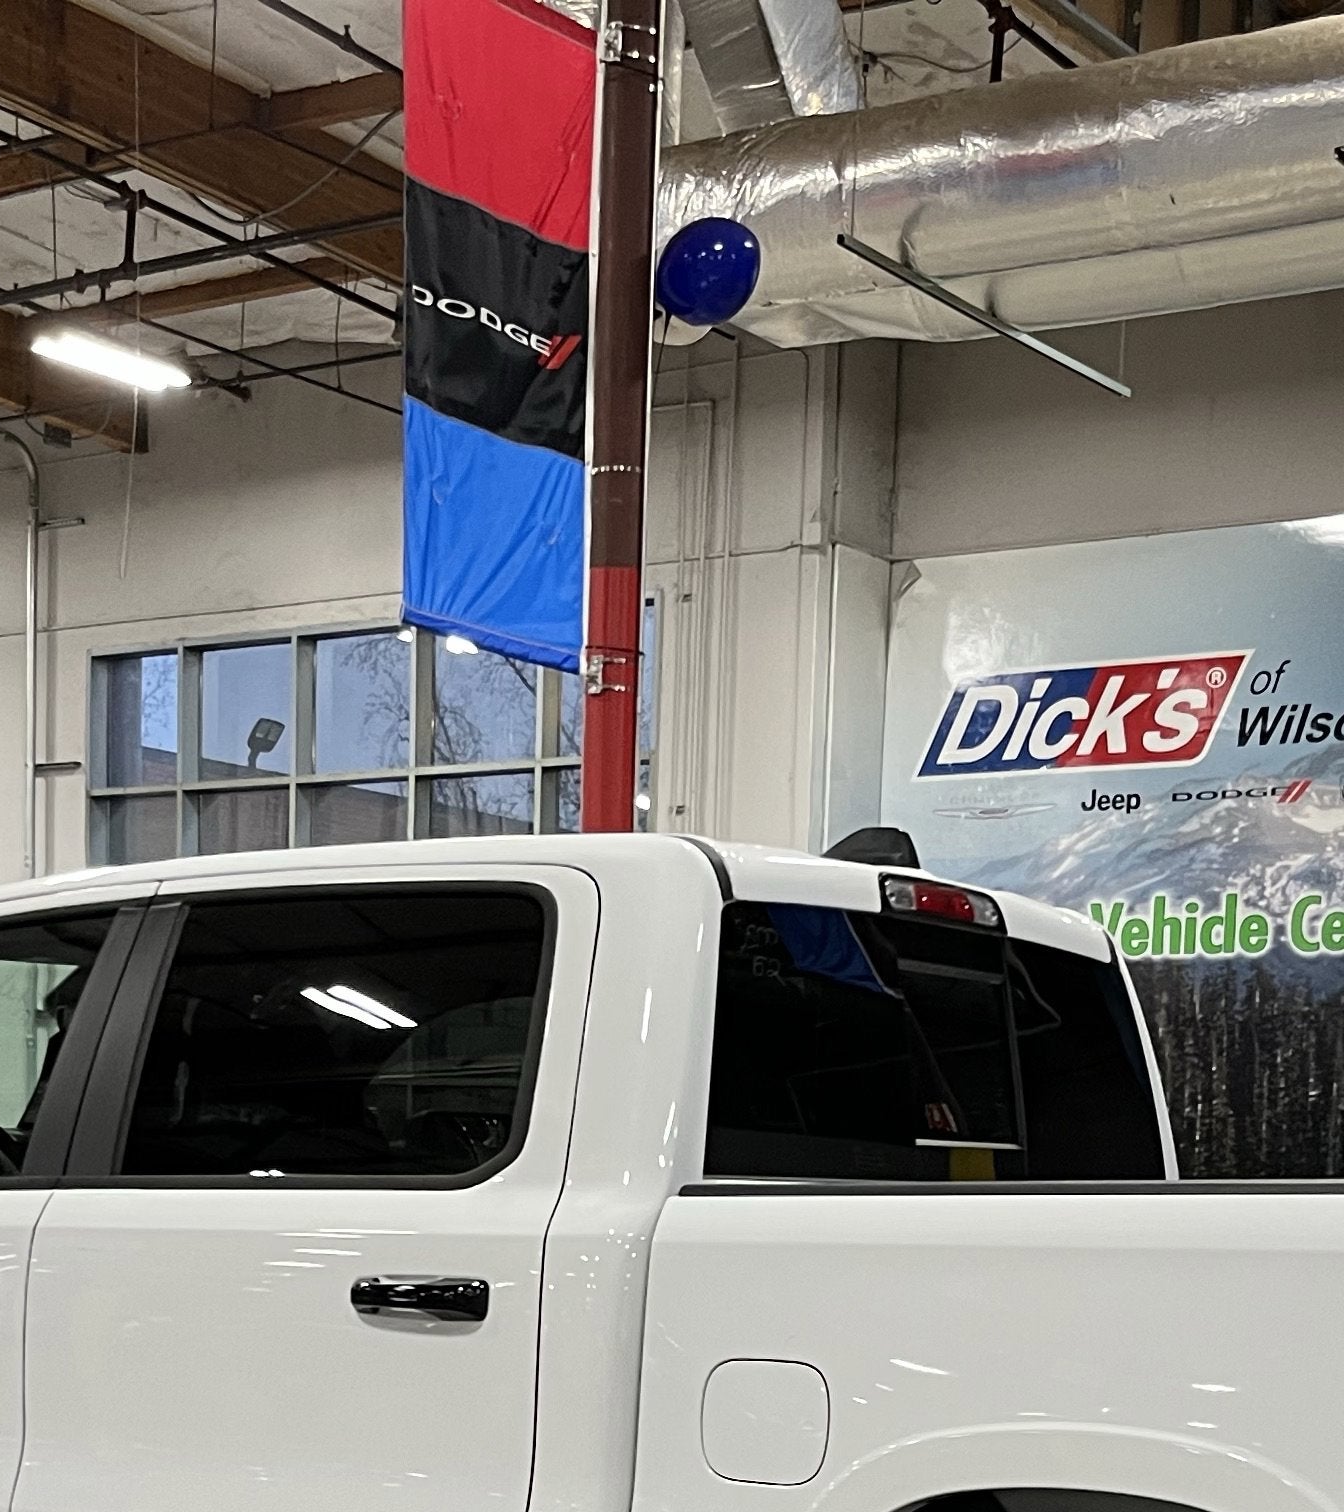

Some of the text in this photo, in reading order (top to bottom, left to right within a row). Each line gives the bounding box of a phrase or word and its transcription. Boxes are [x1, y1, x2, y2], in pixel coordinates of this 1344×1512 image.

[412, 284, 553, 358] DODGE
[1250, 660, 1291, 695] of
[1081, 789, 1141, 814] Jeep
[1090, 893, 1269, 956] Vehicle
